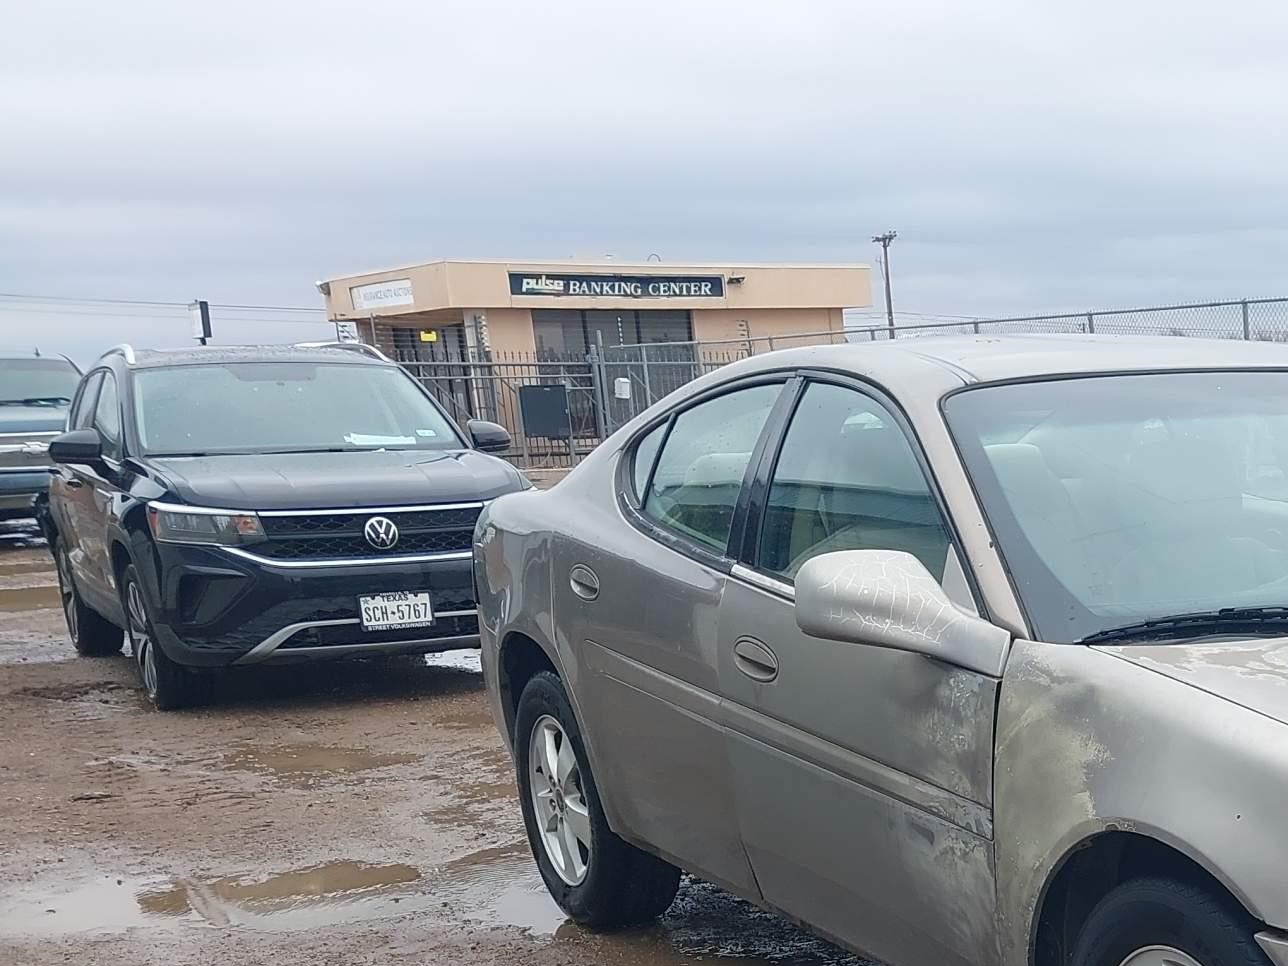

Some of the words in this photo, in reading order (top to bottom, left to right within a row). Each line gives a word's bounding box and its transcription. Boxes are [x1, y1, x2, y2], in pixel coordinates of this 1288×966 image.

[521, 275, 564, 292] pulse
[568, 280, 642, 296] BANKING
[648, 282, 713, 297] CENTER
[381, 594, 409, 602] TEXAS
